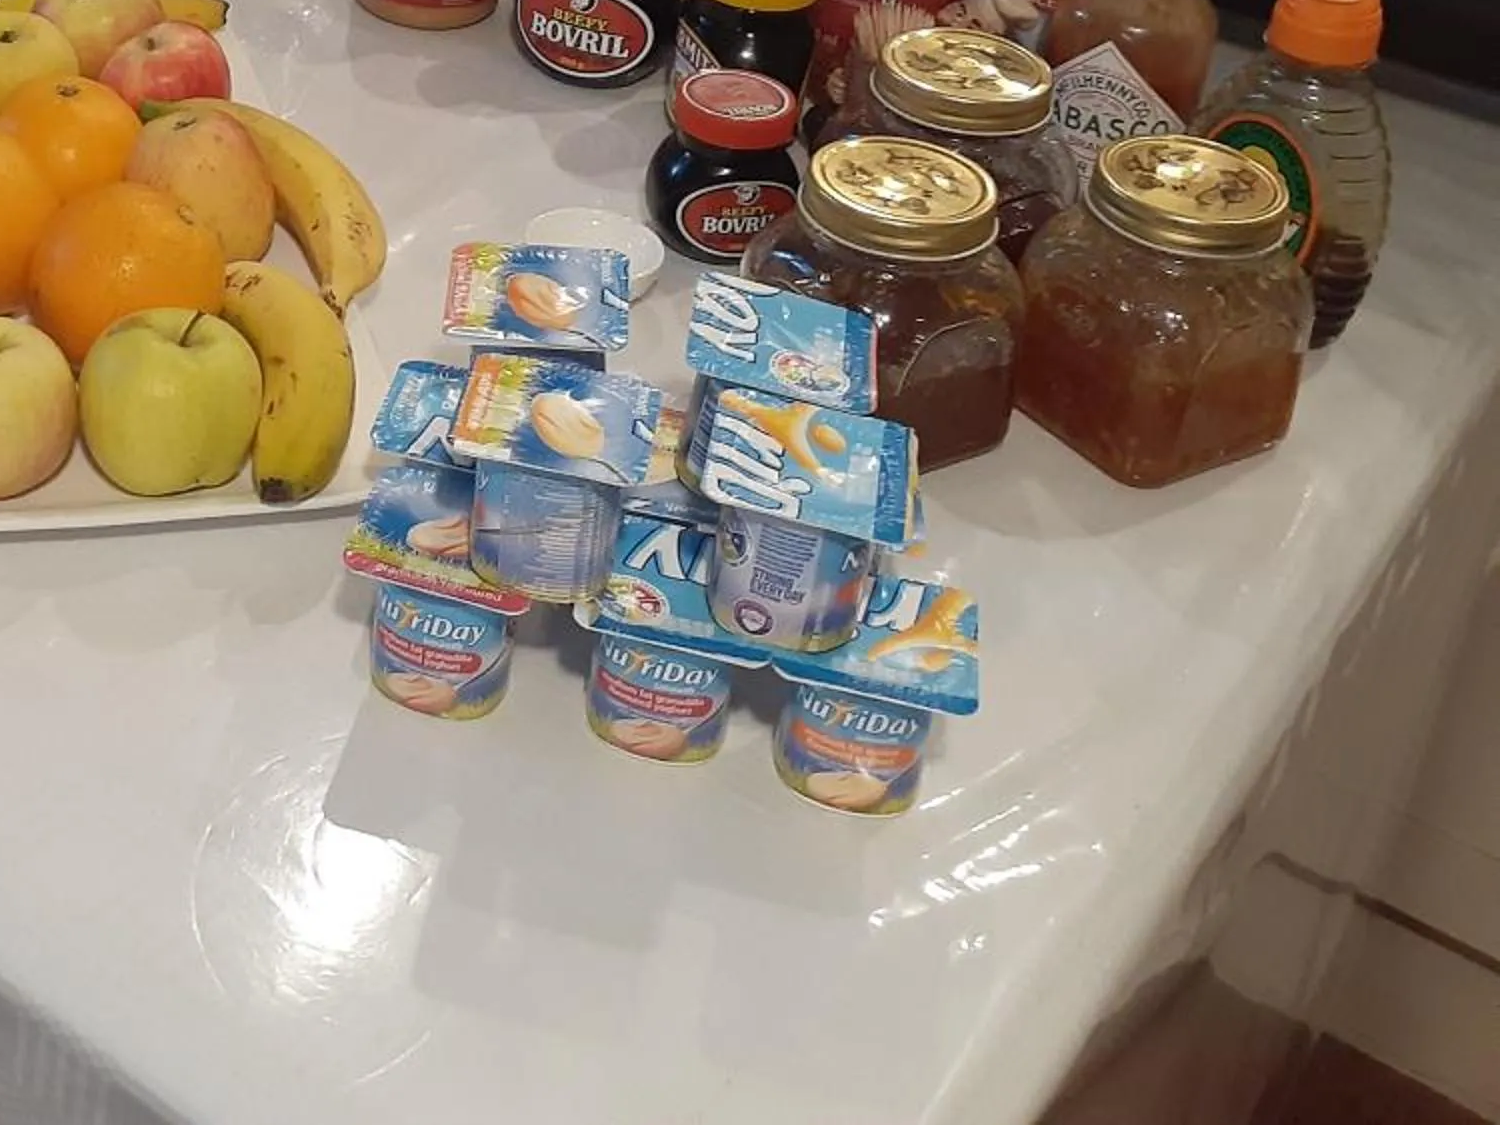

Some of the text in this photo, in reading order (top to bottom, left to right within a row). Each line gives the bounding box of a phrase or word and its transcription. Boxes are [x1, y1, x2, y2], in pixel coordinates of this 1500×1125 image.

[531, 10, 630, 59] BOVRIL
[1052, 98, 1171, 142] ABASCO
[702, 213, 775, 233] BOVRI
